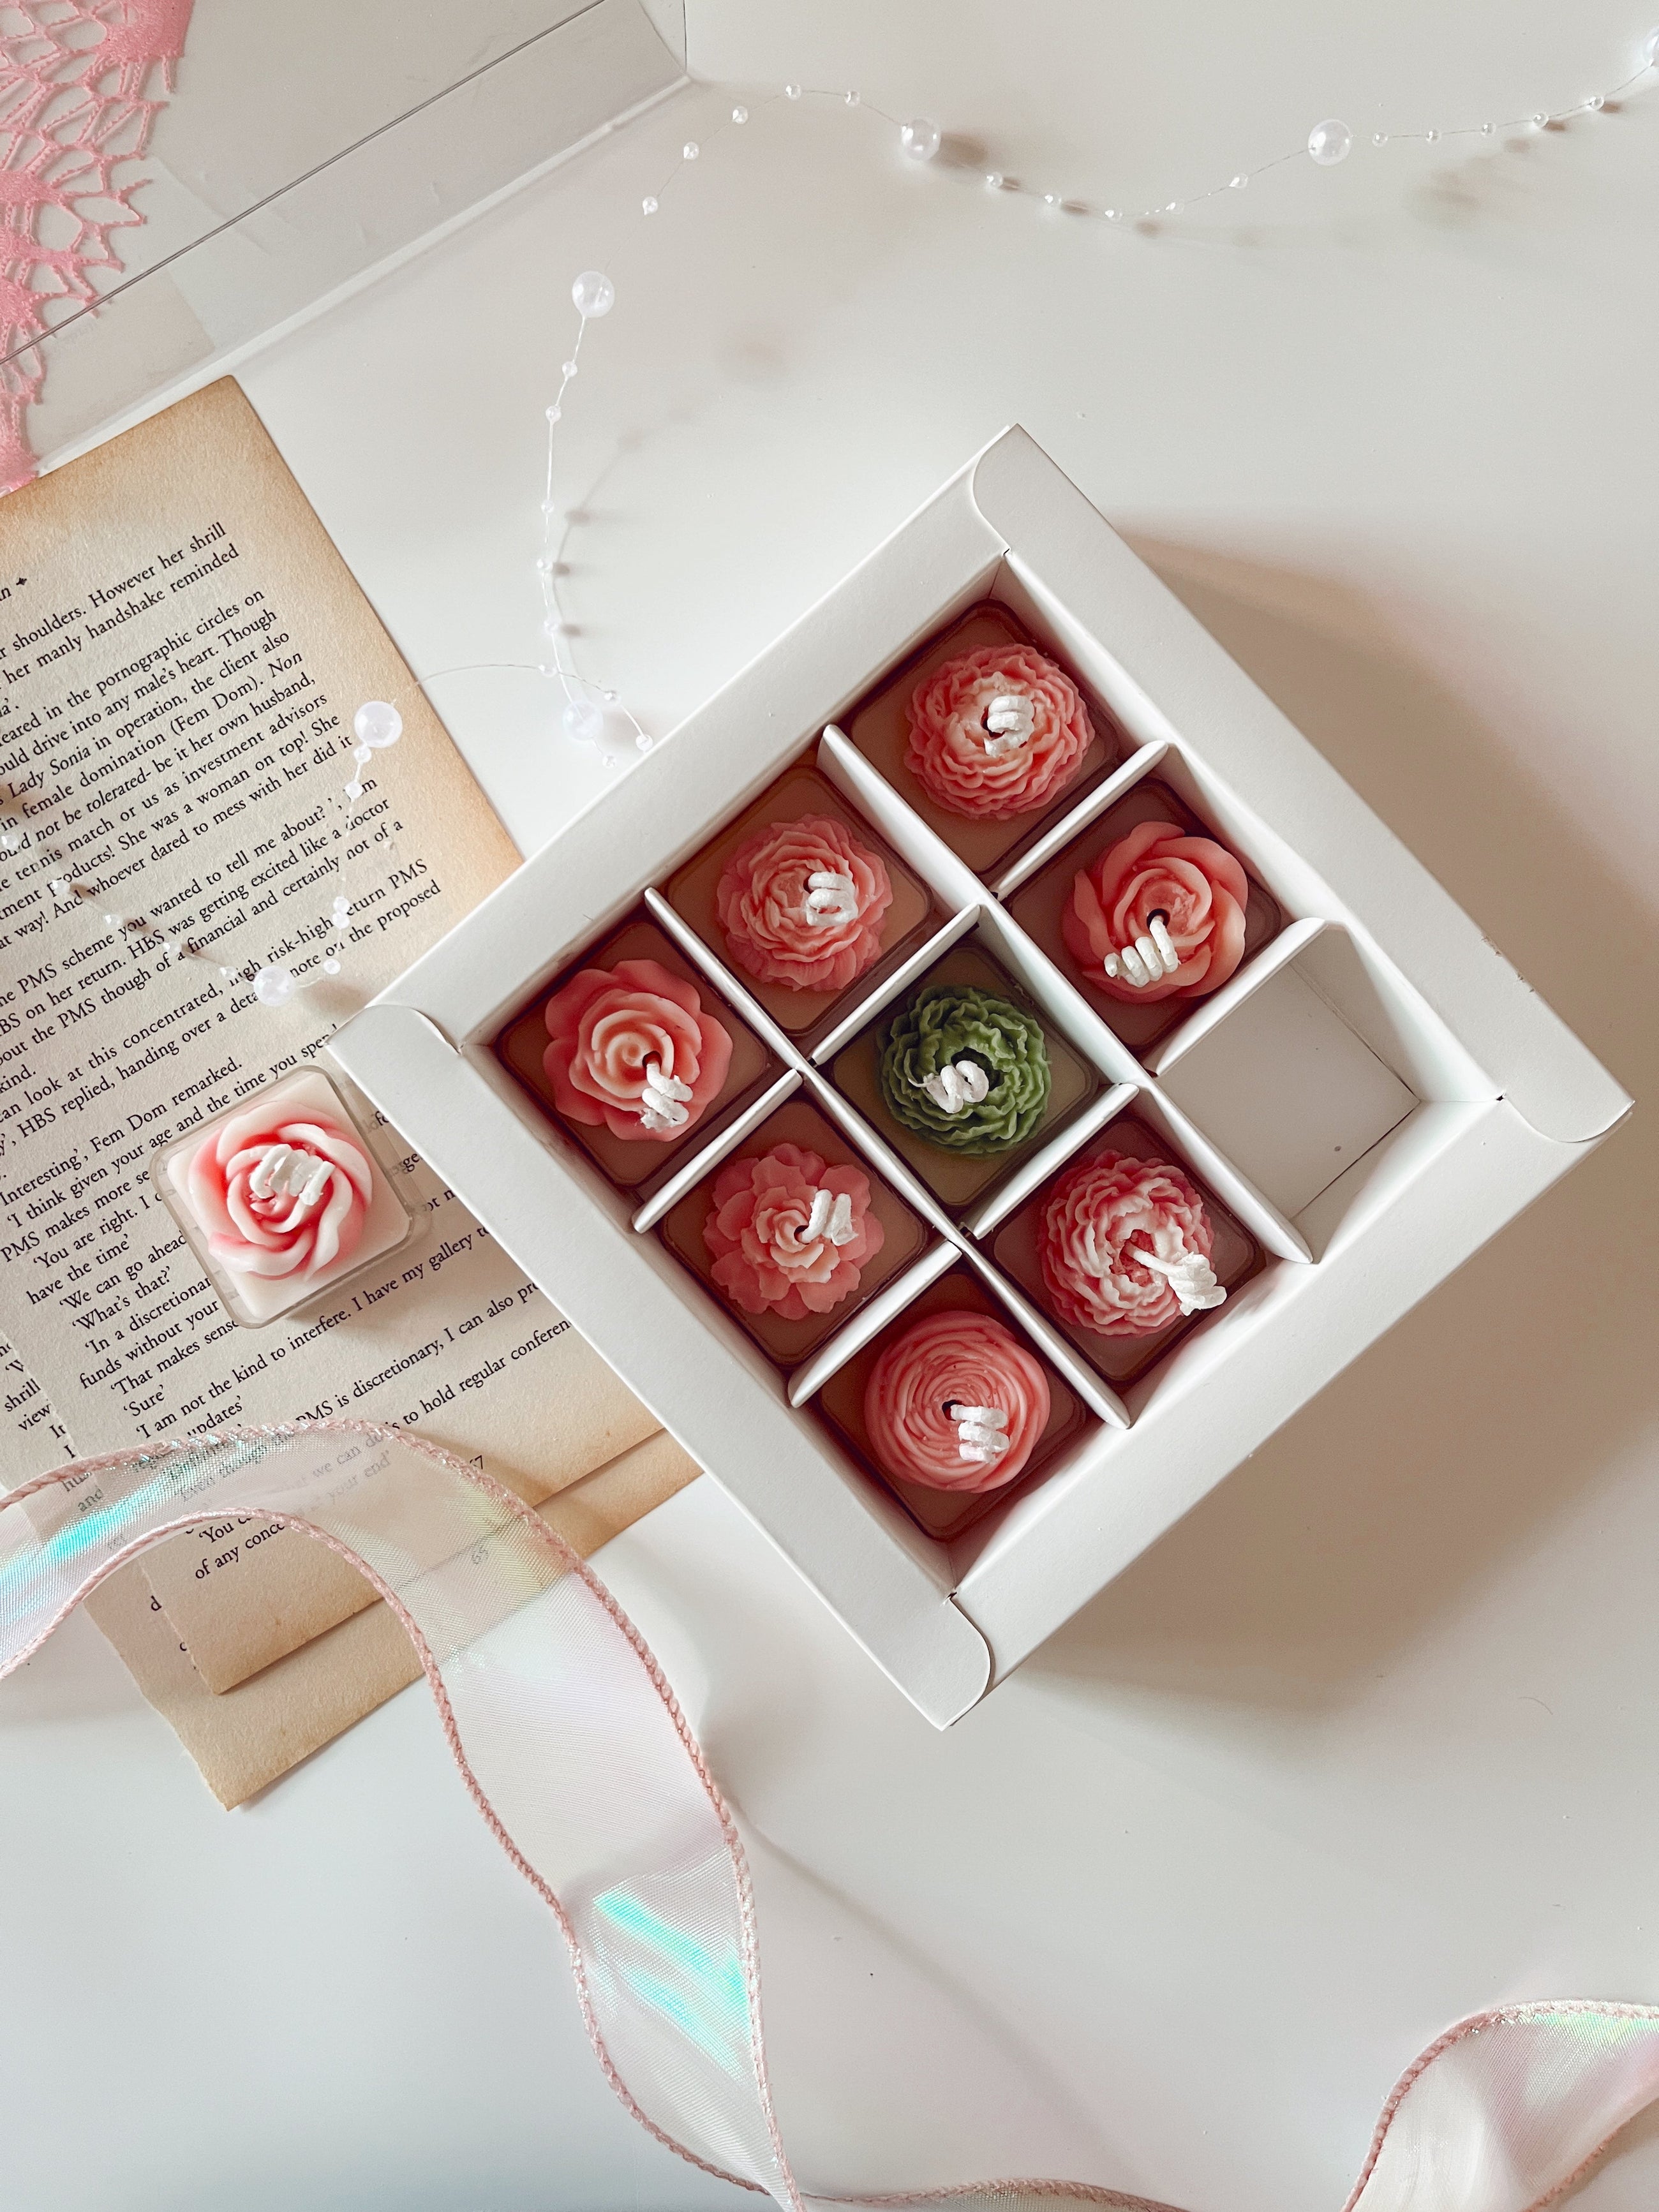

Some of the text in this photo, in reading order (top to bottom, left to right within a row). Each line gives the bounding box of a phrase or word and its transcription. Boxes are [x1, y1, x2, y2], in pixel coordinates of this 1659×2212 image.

[1, 542, 239, 685] her manly handshake reminded
[12, 521, 227, 651] shoulders. However her shrill
[0, 604, 240, 747] eared the pornographic circles
[6, 632, 289, 799] Lady Sonia operation, the client also
[21, 653, 302, 819] female domination (Fem Dom). Non
[32, 731, 70, 755] drive
[69, 713, 101, 734] into
[104, 694, 130, 716] any
[175, 646, 219, 674] heart.
[218, 608, 278, 648] Though
[34, 671, 315, 842] not tolerated- her own husband,
[67, 817, 115, 852] match
[181, 732, 265, 785] investment
[269, 694, 327, 734] advisors
[117, 829, 147, 850] She
[150, 811, 179, 831] was
[195, 769, 251, 805] woman
[278, 730, 308, 756] top!
[311, 715, 340, 736] She
[13, 741, 338, 938] way! And whoever dared mess with her did
[16, 805, 325, 994] PMS scheme you wanted tell me about?
[23, 1076, 63, 1106] look
[87, 1046, 117, 1069] this
[123, 983, 223, 1049] concentrated,
[267, 916, 334, 963] risk-high
[387, 858, 427, 889] PMS
[31, 840, 370, 1044] the PMS though financial and certainly not
[45, 985, 74, 1006] her
[77, 959, 126, 990] return.
[126, 928, 165, 960] HBS
[167, 915, 195, 935] was
[198, 884, 249, 923] getting
[251, 849, 299, 887] excited
[299, 836, 329, 857] like
[16, 1107, 56, 1138] HBS
[61, 1074, 115, 1115] replied,
[115, 1040, 180, 1081] handing
[181, 1019, 212, 1043] over
[289, 954, 321, 976] note
[348, 924, 373, 942] the
[376, 879, 441, 932] proposed
[26, 1189, 68, 1219] think
[70, 1168, 109, 1199] given
[110, 1145, 144, 1175] your
[149, 1129, 173, 1148] age
[176, 1105, 204, 1132] and
[206, 1094, 230, 1113] the
[233, 1073, 267, 1097] time
[269, 1055, 298, 1080] you
[89, 1129, 126, 1154] Fem
[125, 1104, 168, 1131] Dom
[171, 1056, 242, 1106] remarked.
[0, 1182, 132, 1263] PMS makes more
[25, 1279, 64, 1305] have
[66, 1263, 93, 1282] the
[73, 1232, 96, 1251] are
[98, 1208, 138, 1235] right.
[96, 1274, 122, 1294] can
[79, 1300, 219, 1390] funds without your
[129, 1277, 211, 1332] discretionar
[156, 1341, 200, 1373] makes
[180, 1395, 206, 1416] not
[207, 1379, 232, 1399] the
[231, 1353, 269, 1384] kind
[286, 1310, 352, 1351] interfere.
[362, 1279, 399, 1305] have
[401, 1263, 424, 1283] my
[428, 1233, 472, 1272] gallery
[353, 1339, 444, 1398] discretionary,
[458, 1315, 484, 1334] can
[486, 1296, 514, 1318] also
[419, 1383, 456, 1414] hold
[458, 1357, 507, 1392] regular
[510, 1320, 571, 1360] conferen
[214, 1546, 239, 1568] any
